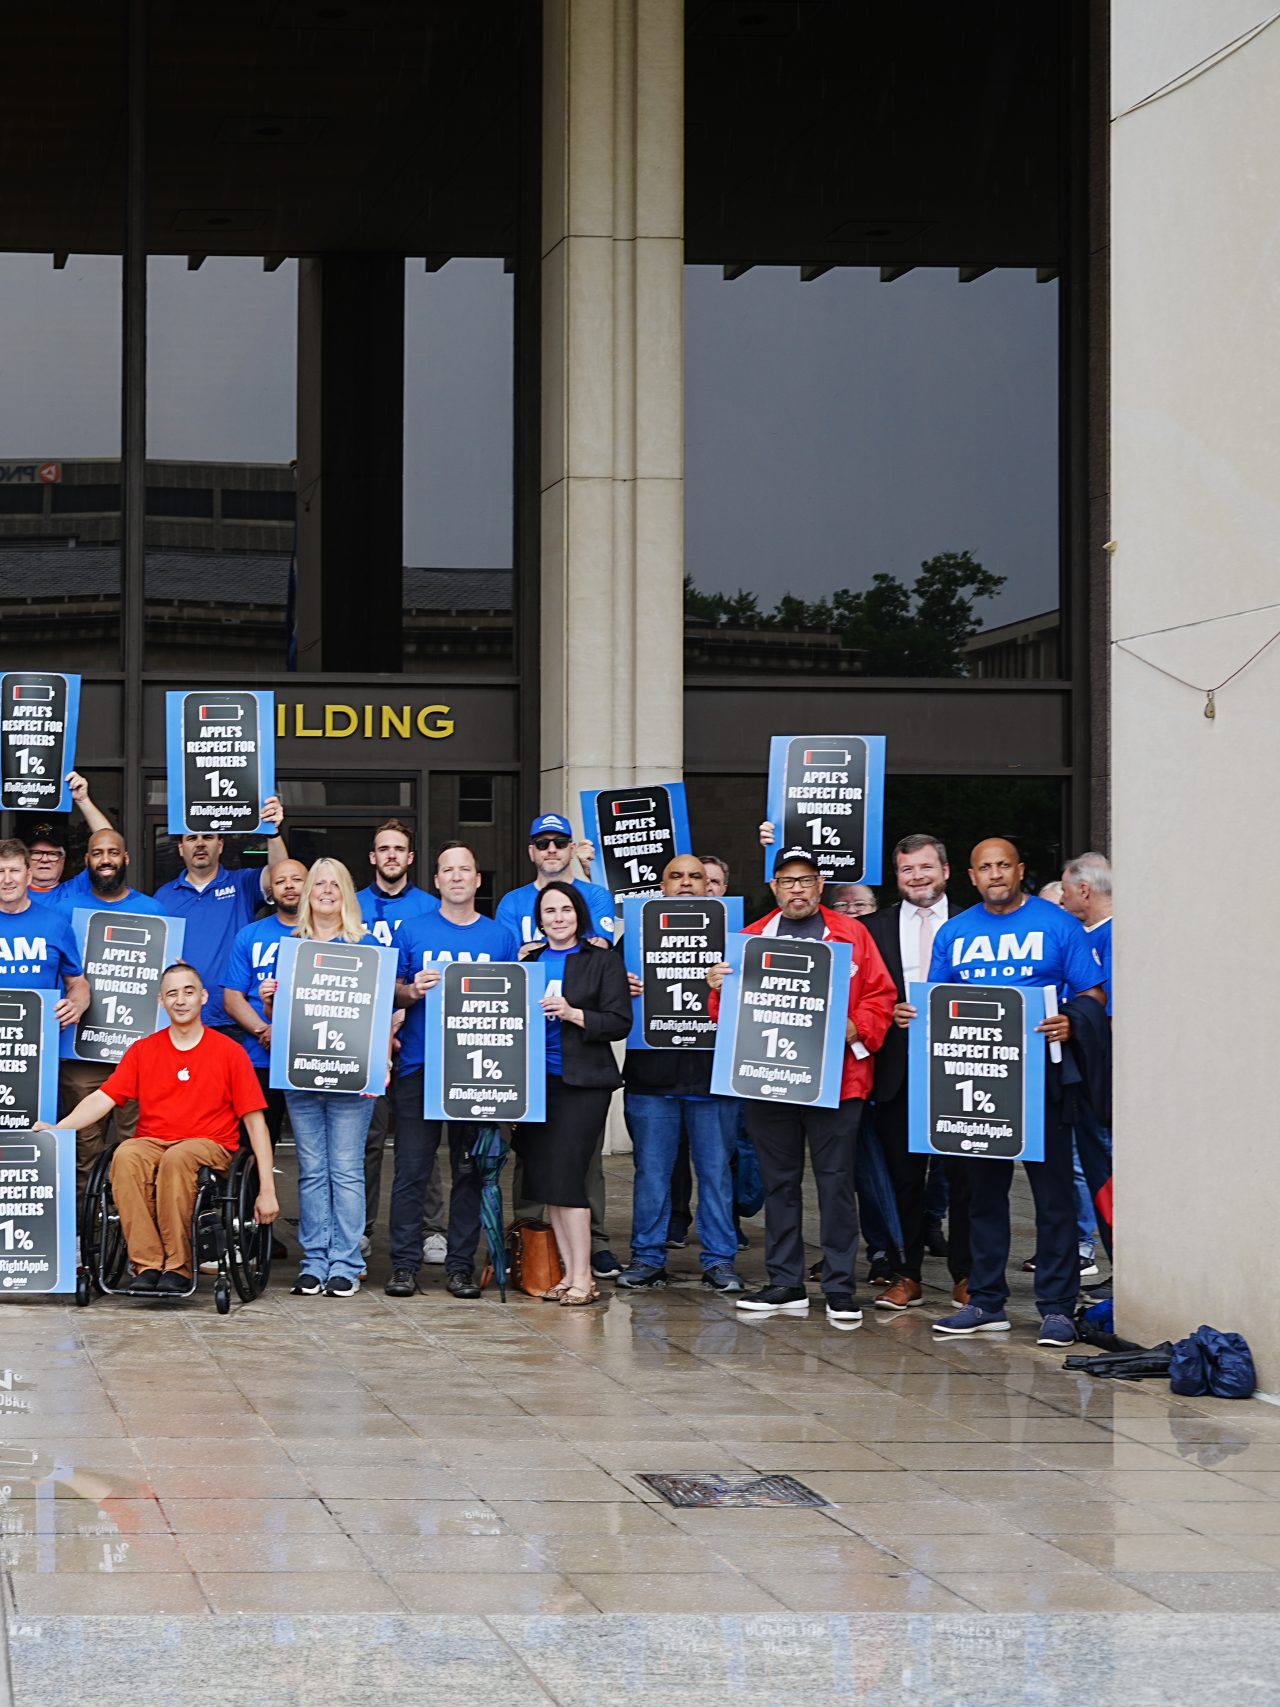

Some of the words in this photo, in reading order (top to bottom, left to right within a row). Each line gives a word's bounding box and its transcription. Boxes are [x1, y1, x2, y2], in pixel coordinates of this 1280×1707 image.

[13, 706, 52, 717] APPLE'S
[3, 720, 43, 731] RESPECT
[44, 721, 62, 732] FOR
[277, 703, 455, 739] ILDING
[200, 726, 242, 737] APPLE'S
[9, 734, 55, 746] WORKERS
[187, 741, 233, 752] RESPECT
[235, 741, 255, 752] FOR
[16, 748, 45, 774] 1%
[196, 756, 247, 767] WORKERS
[205, 771, 237, 797] 1%
[803, 772, 848, 784] APPLE'S
[788, 787, 837, 799] RESPECT
[839, 788, 862, 799] FOR
[190, 805, 251, 817] #DoRightApple
[797, 802, 852, 815] WORKERS
[615, 817, 656, 831] APPLE'S
[806, 818, 840, 845] 1%
[604, 831, 647, 845] RESPECT
[650, 829, 670, 840] FOR
[614, 843, 663, 857] WORKERS
[817, 854, 856, 867] ghtApple
[624, 859, 657, 883] 1%
[661, 936, 707, 947] APPLE'S
[102, 948, 146, 963] APPLE'S
[952, 932, 1044, 967] IAM
[647, 952, 697, 963] RESPECT
[699, 952, 724, 965] FOR
[87, 962, 135, 978] RESPECT
[136, 967, 158, 980] FOR
[960, 966, 1034, 980] UNION
[95, 979, 147, 995] WORKERS
[312, 974, 358, 988] APPLE'S
[761, 976, 810, 992] APPLE'S
[296, 988, 346, 1002] RESPECT
[348, 992, 371, 1004] FOR
[667, 983, 702, 1011] 1%
[744, 991, 798, 1008] RESPECT
[800, 997, 824, 1011] FOR
[102, 996, 133, 1025] 1%
[305, 1004, 360, 1019] WORKERS
[462, 1000, 508, 1013] APPLE'S
[447, 1016, 498, 1029] RESPECT
[500, 1017, 523, 1030] FOR
[753, 1009, 812, 1027] WORKERS
[650, 1020, 717, 1033] #DoRightApple
[950, 1026, 1002, 1041] APPLE'S
[313, 1021, 345, 1051] 1%
[457, 1033, 513, 1046] WORKERS
[15, 1044, 37, 1056] FOR
[762, 1028, 797, 1060] 1%
[934, 1043, 990, 1058] RESPECT
[993, 1046, 1019, 1060] FOR
[293, 1058, 360, 1074] #DoRightApple
[467, 1050, 502, 1079] 1%
[944, 1061, 1008, 1077] WORKERS
[739, 1065, 811, 1084] #DoRightApple
[449, 1088, 517, 1102] #DoRightApple
[956, 1080, 995, 1113] 1%
[936, 1120, 1012, 1138] #DoRightApple
[30, 1186, 53, 1199] FOR
[0, 1220, 33, 1250] 1%
